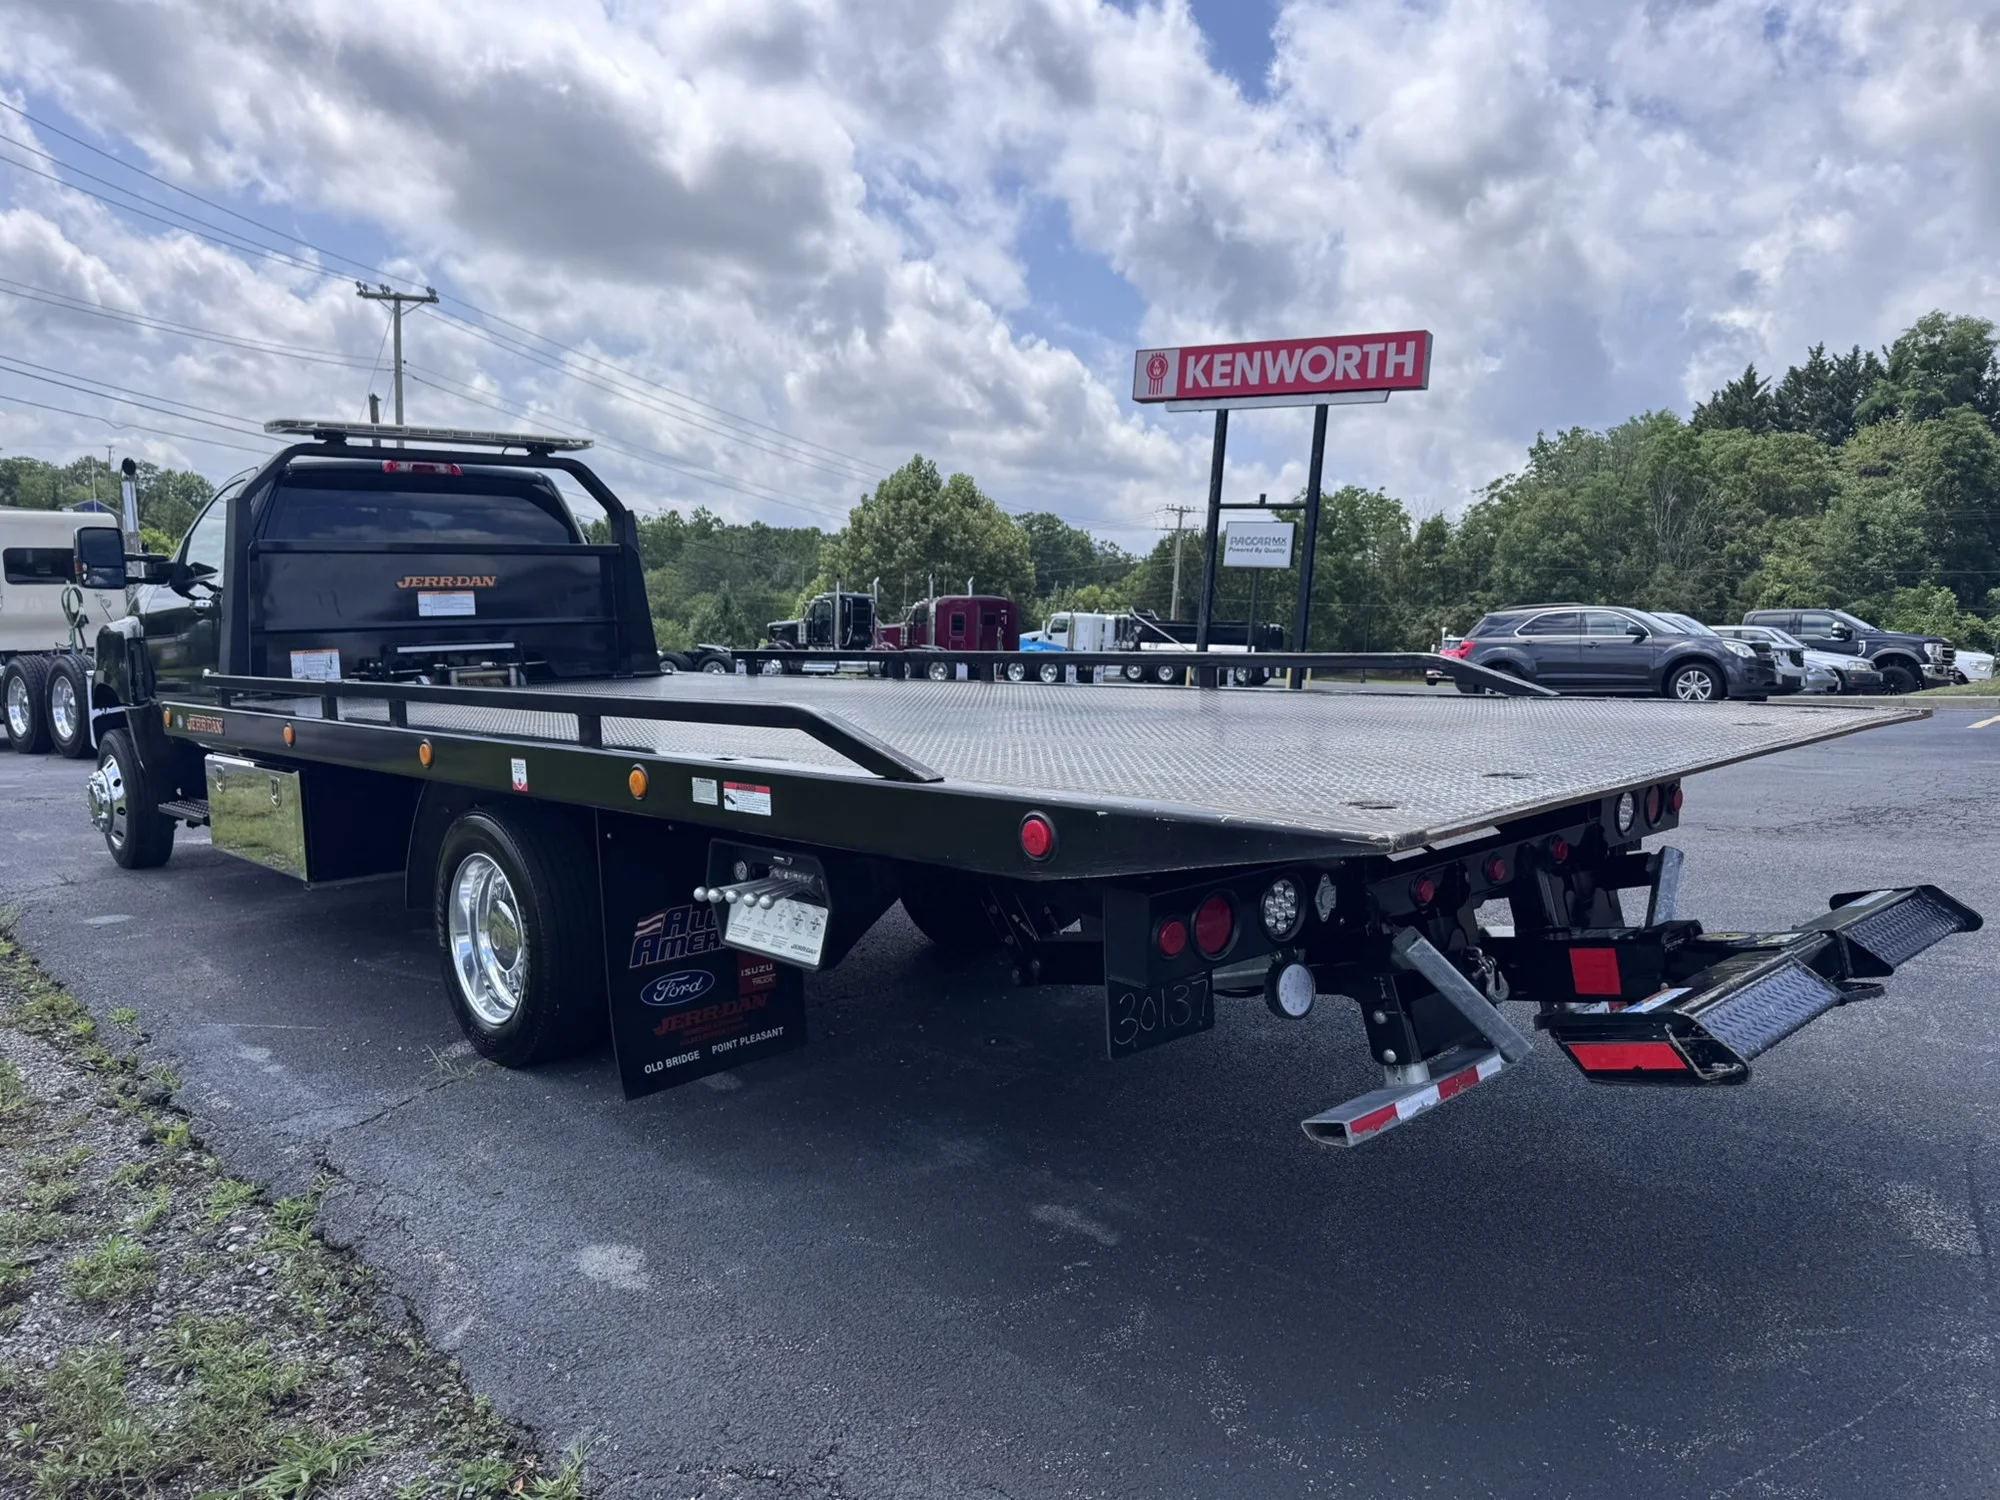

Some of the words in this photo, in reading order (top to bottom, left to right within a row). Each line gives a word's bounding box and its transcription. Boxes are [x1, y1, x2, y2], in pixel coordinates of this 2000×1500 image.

[1184, 341, 1416, 389] KENWORTH
[653, 975, 704, 1002] Ford
[741, 963, 773, 977] ISUZU
[1114, 979, 1208, 1045] 30137
[644, 1060, 664, 1074] OLD
[665, 1050, 701, 1068] BRIDGE
[711, 1039, 738, 1054] POINT
[739, 1026, 785, 1046] PLEASANT
